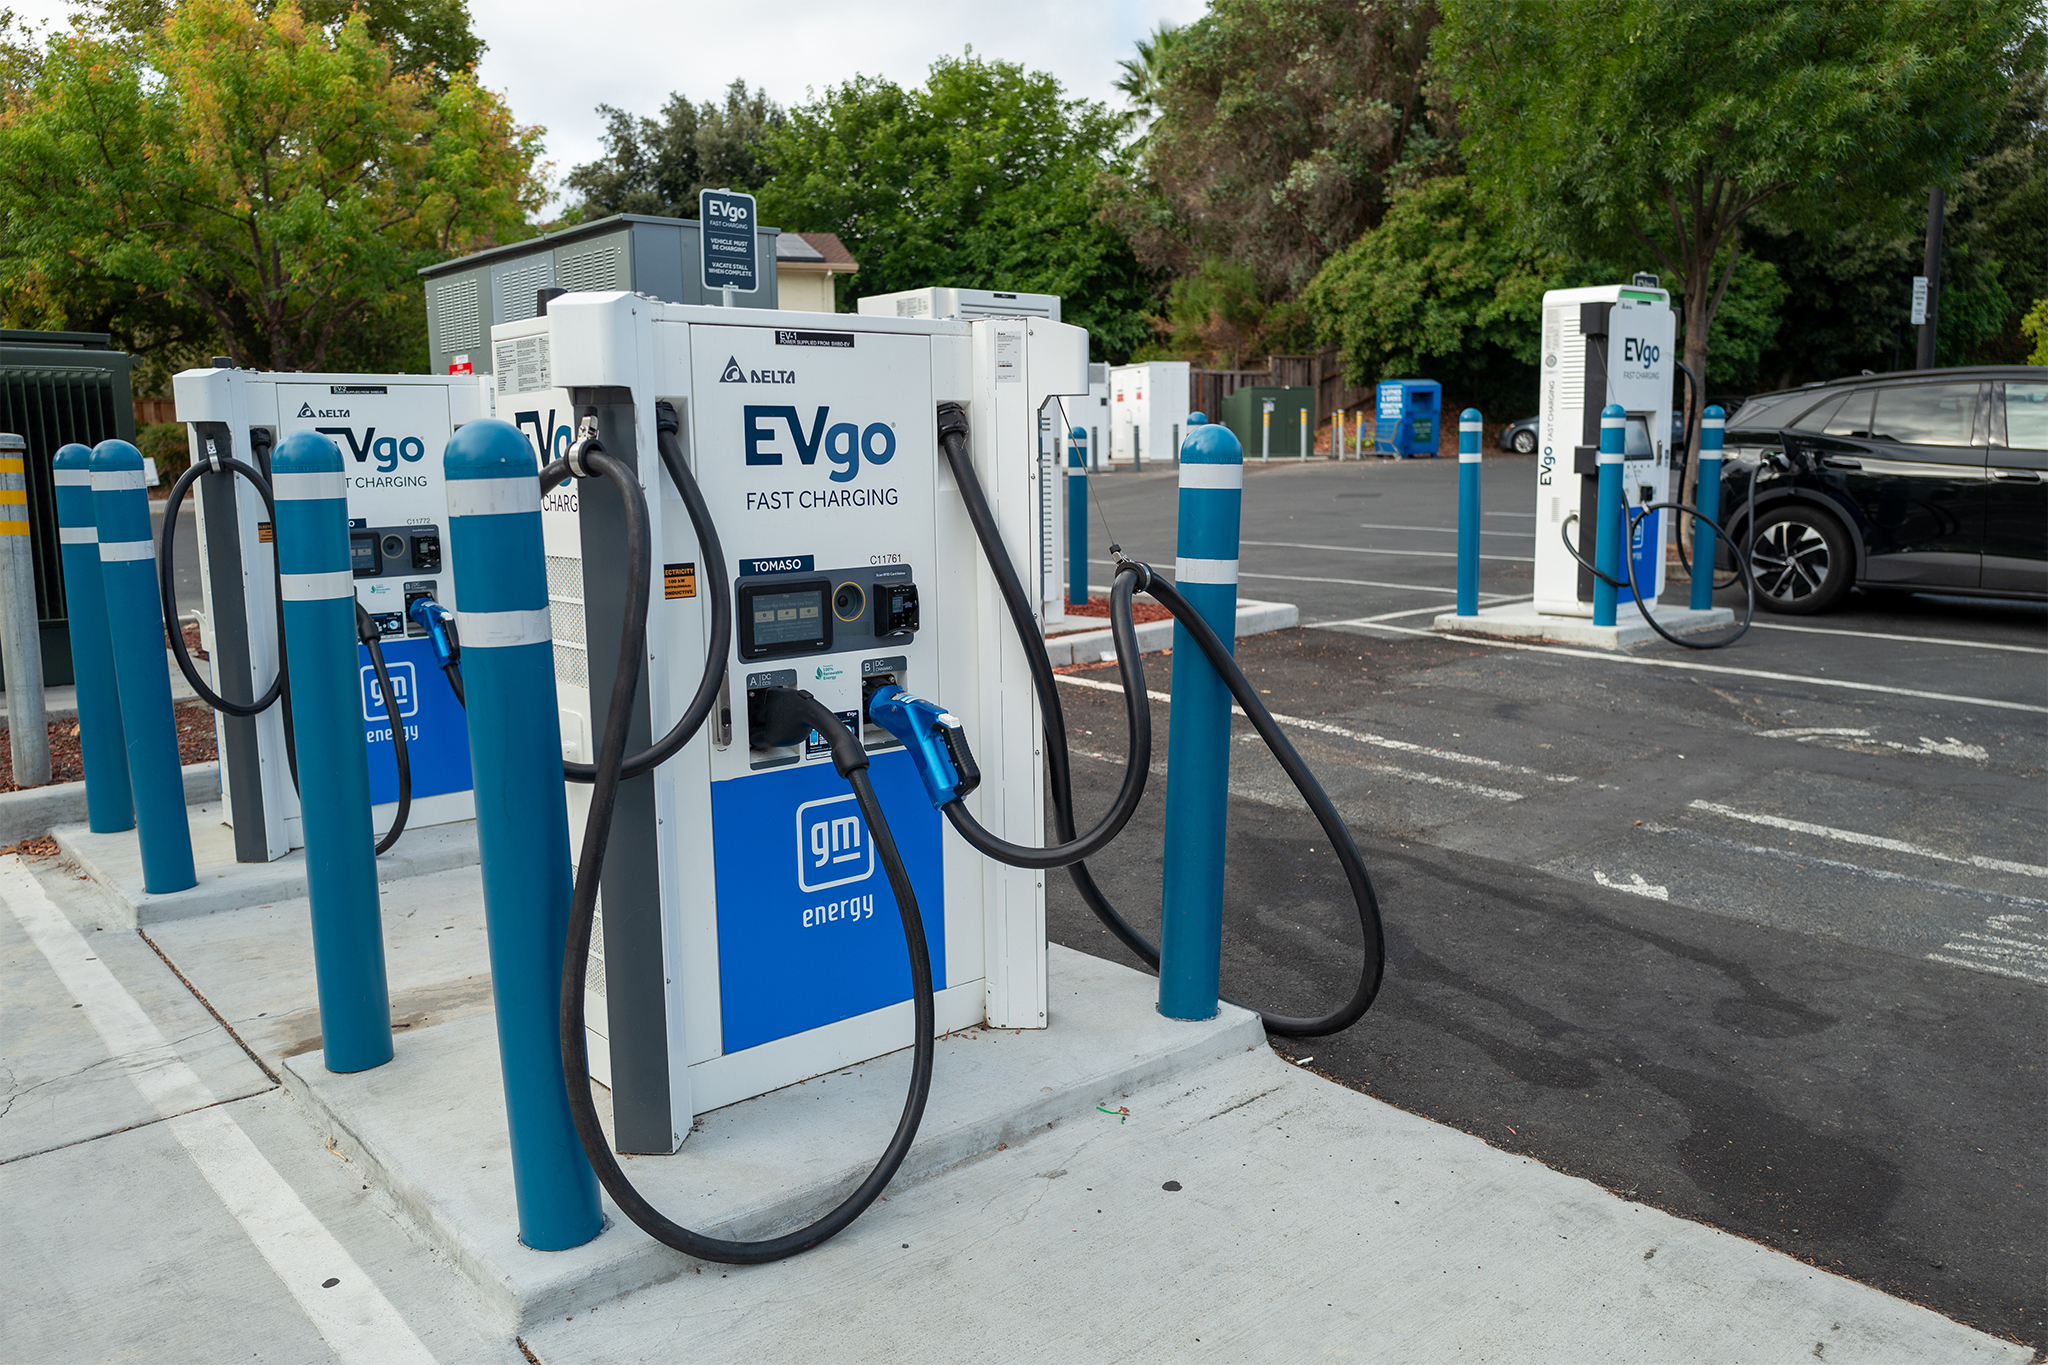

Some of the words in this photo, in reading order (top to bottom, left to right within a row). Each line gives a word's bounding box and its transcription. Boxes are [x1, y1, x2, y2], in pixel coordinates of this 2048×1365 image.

[709, 200, 748, 222] EVgo
[722, 221, 748, 230] CHARGING
[710, 238, 732, 246] VEHICLE
[720, 245, 747, 253] CHARGING
[725, 269, 752, 277] COMPLETE
[780, 331, 797, 340] EV-1
[1625, 337, 1660, 369] EVgo
[751, 369, 796, 384] DELTA
[1623, 371, 1635, 379] FAST
[1636, 371, 1659, 380] CHARGING
[1547, 380, 1555, 422] CHARGING
[319, 409, 351, 418] DELTA
[743, 404, 897, 483] EVgo
[1540, 446, 1556, 486] EVgo
[355, 475, 428, 489] CHARGING
[543, 494, 578, 512] CHARG
[746, 491, 794, 510] FAST
[799, 488, 898, 509] CHARGING
[406, 517, 431, 525] C11772
[753, 558, 802, 572] TOMASO
[870, 553, 902, 565] C11761
[864, 663, 870, 671] B
[750, 677, 757, 686] A
[762, 673, 771, 681] DC
[366, 725, 419, 743] enegy
[811, 816, 861, 868] gm
[802, 894, 874, 928] energy
